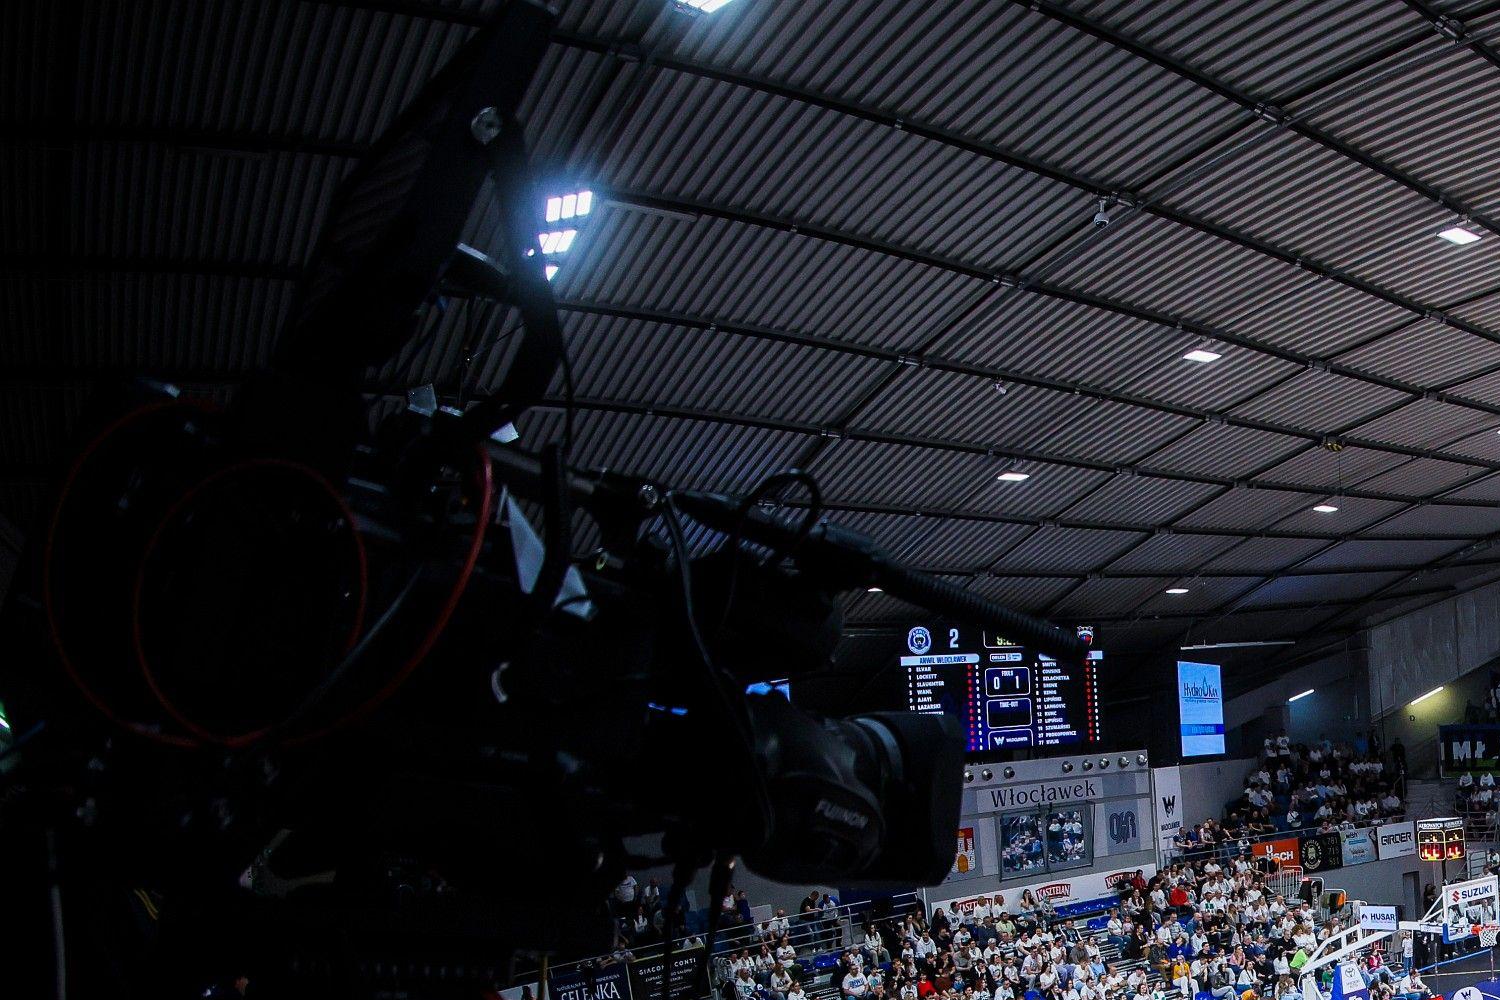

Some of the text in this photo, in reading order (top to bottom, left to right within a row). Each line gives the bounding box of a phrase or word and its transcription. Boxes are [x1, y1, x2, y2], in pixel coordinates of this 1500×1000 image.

[949, 628, 959, 648] 2
[993, 675, 1019, 690] 0 1
[991, 779, 1096, 808] Włocławek
[1461, 885, 1492, 899] SUZUKI
[1370, 913, 1396, 922] HUSAR
[638, 957, 696, 976] GIACO CONTI
